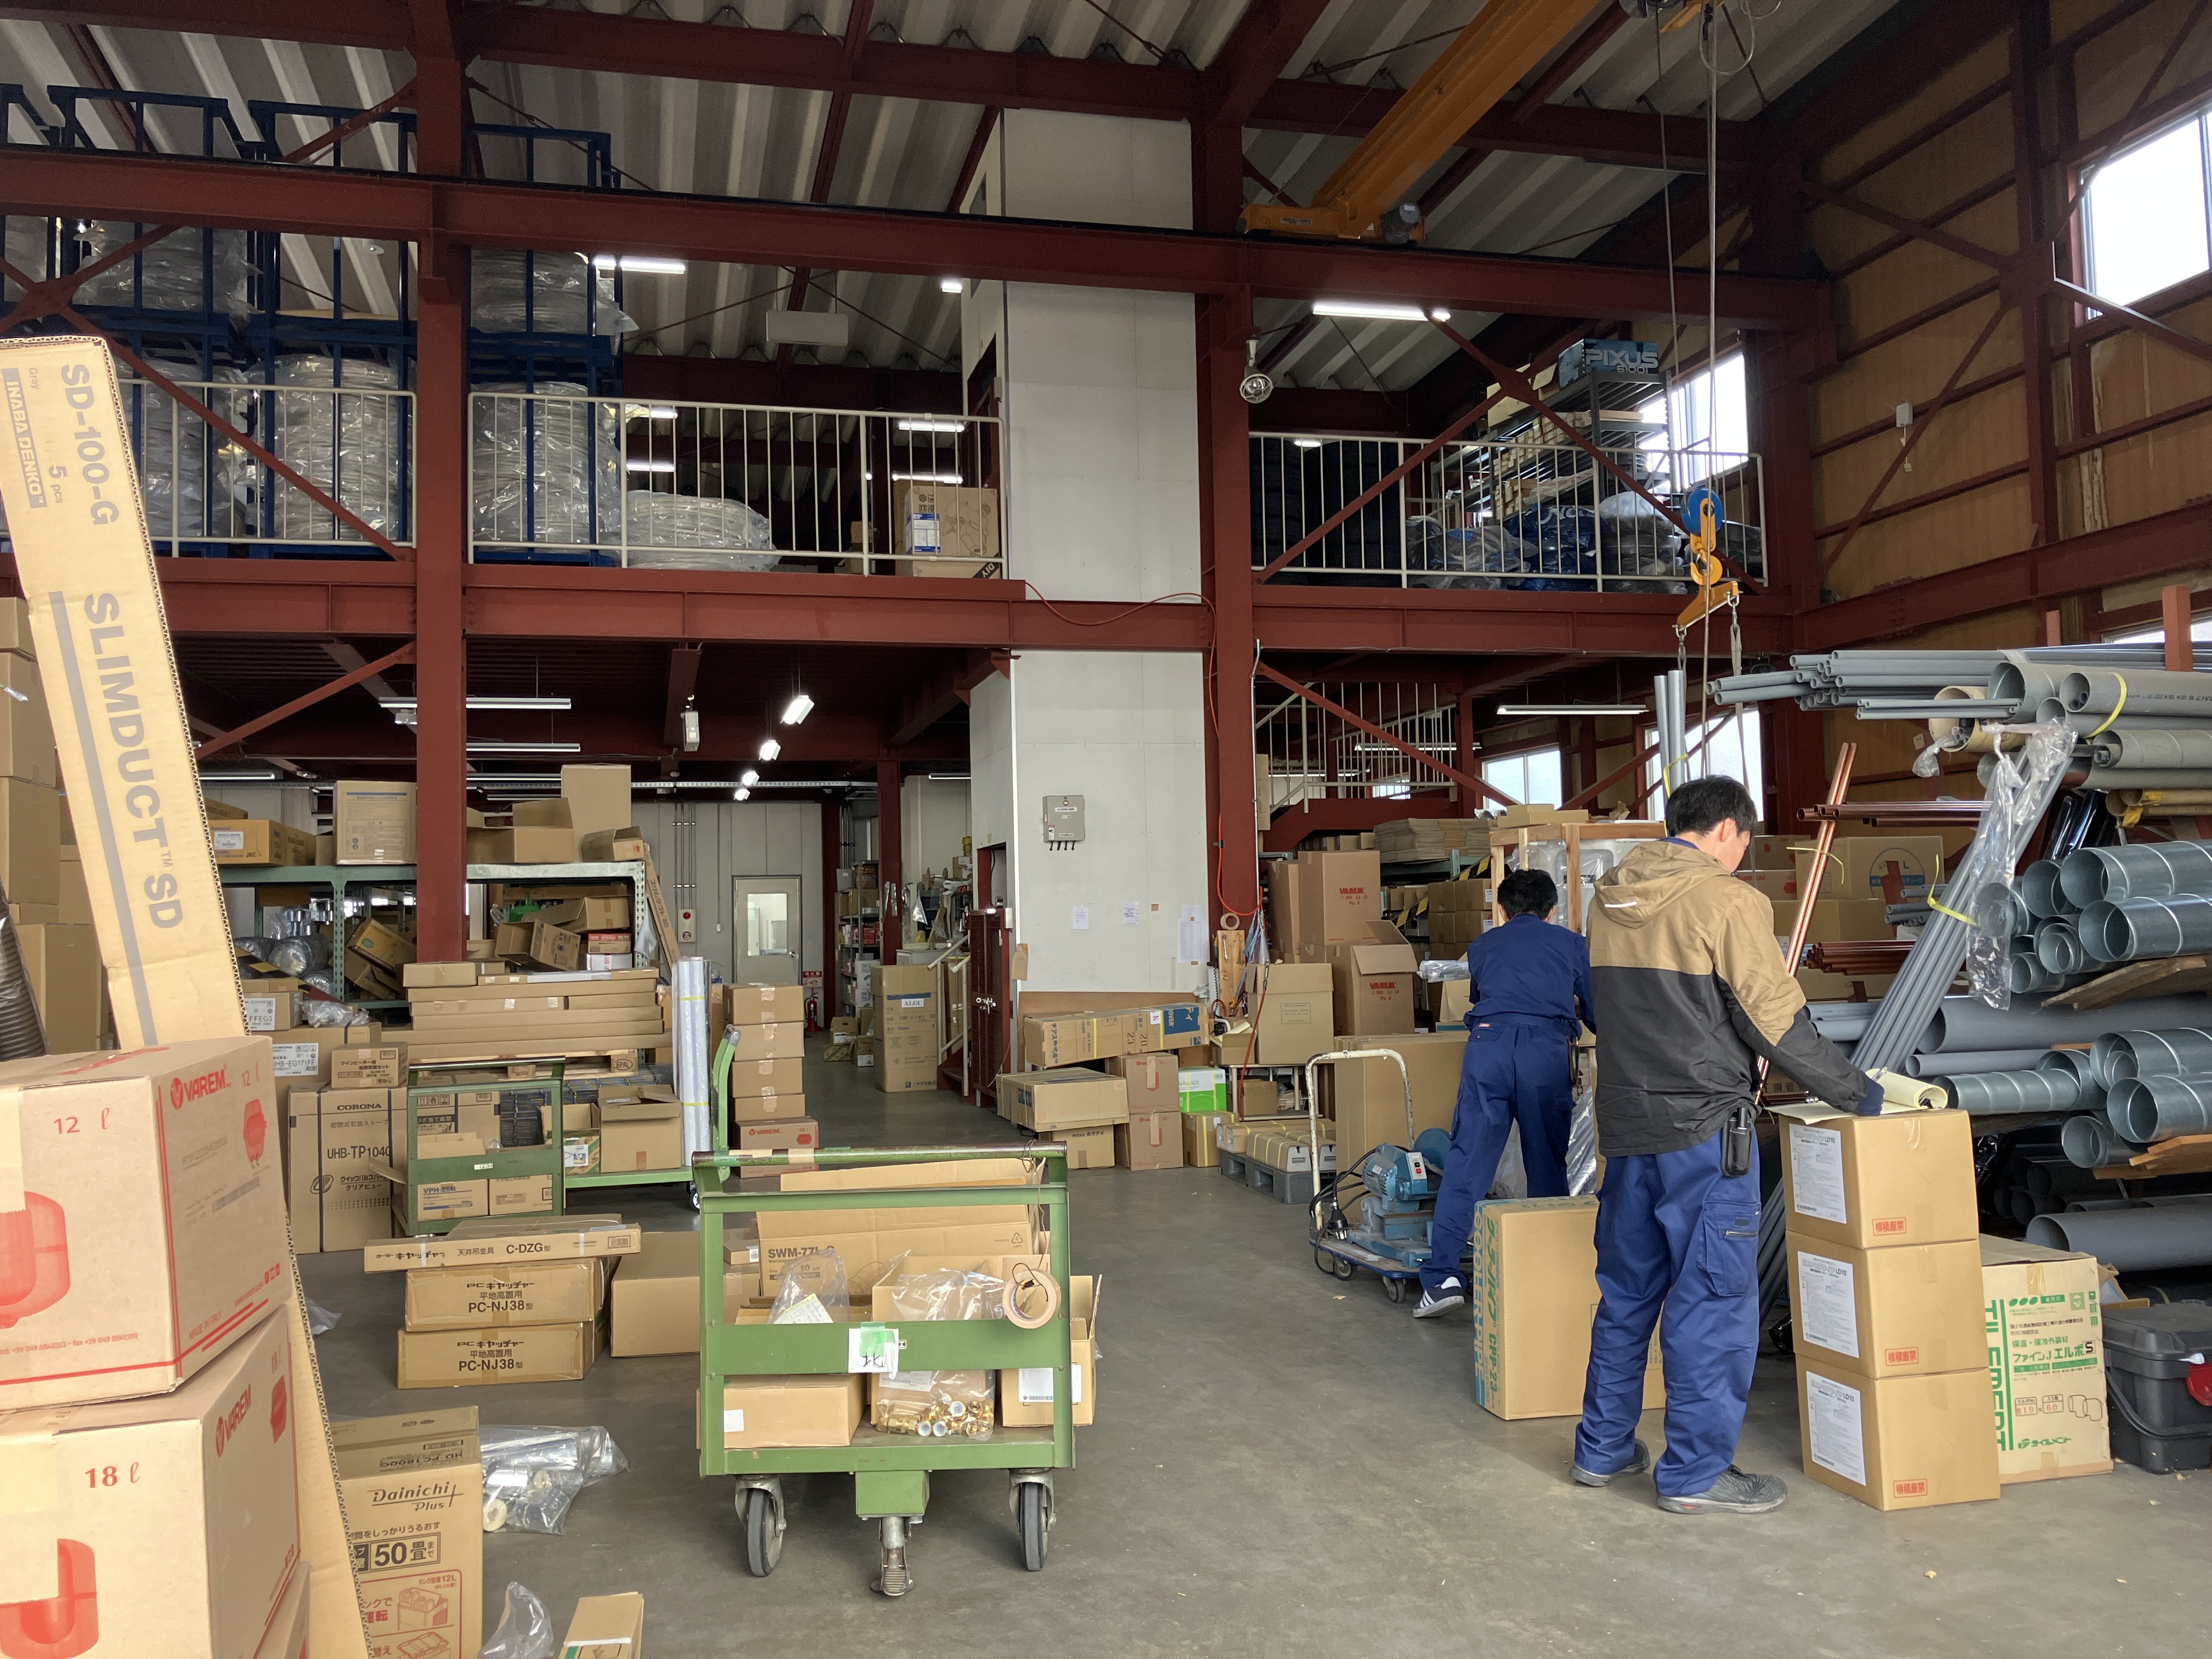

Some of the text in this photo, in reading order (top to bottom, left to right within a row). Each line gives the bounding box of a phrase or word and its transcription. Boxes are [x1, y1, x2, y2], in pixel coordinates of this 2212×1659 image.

[1585, 349, 1658, 369] PIXUS
[29, 367, 40, 391] Gray
[6, 382, 27, 433] INABA
[61, 364, 119, 526] SD-100-G
[48, 465, 68, 504] 5 pcs
[981, 562, 996, 578] DIY
[144, 873, 183, 930] SD
[184, 1069, 226, 1103] VAREM
[242, 1070, 251, 1087] 12
[337, 1103, 382, 1111] CORONA
[53, 1116, 80, 1134] 12
[458, 1246, 494, 1256] 天井吊金具
[479, 1290, 523, 1300] 平地高置用
[468, 1300, 534, 1313] PC-NJ38型
[470, 1348, 512, 1359] 平地高置用
[1489, 1333, 1498, 1392] CPP-23
[459, 1359, 523, 1372] PC-NJ38型
[224, 1384, 252, 1442] VAREM
[85, 1466, 118, 1489] 18
[368, 1481, 450, 1503] Dainichi
[415, 1500, 445, 1512] Plus
